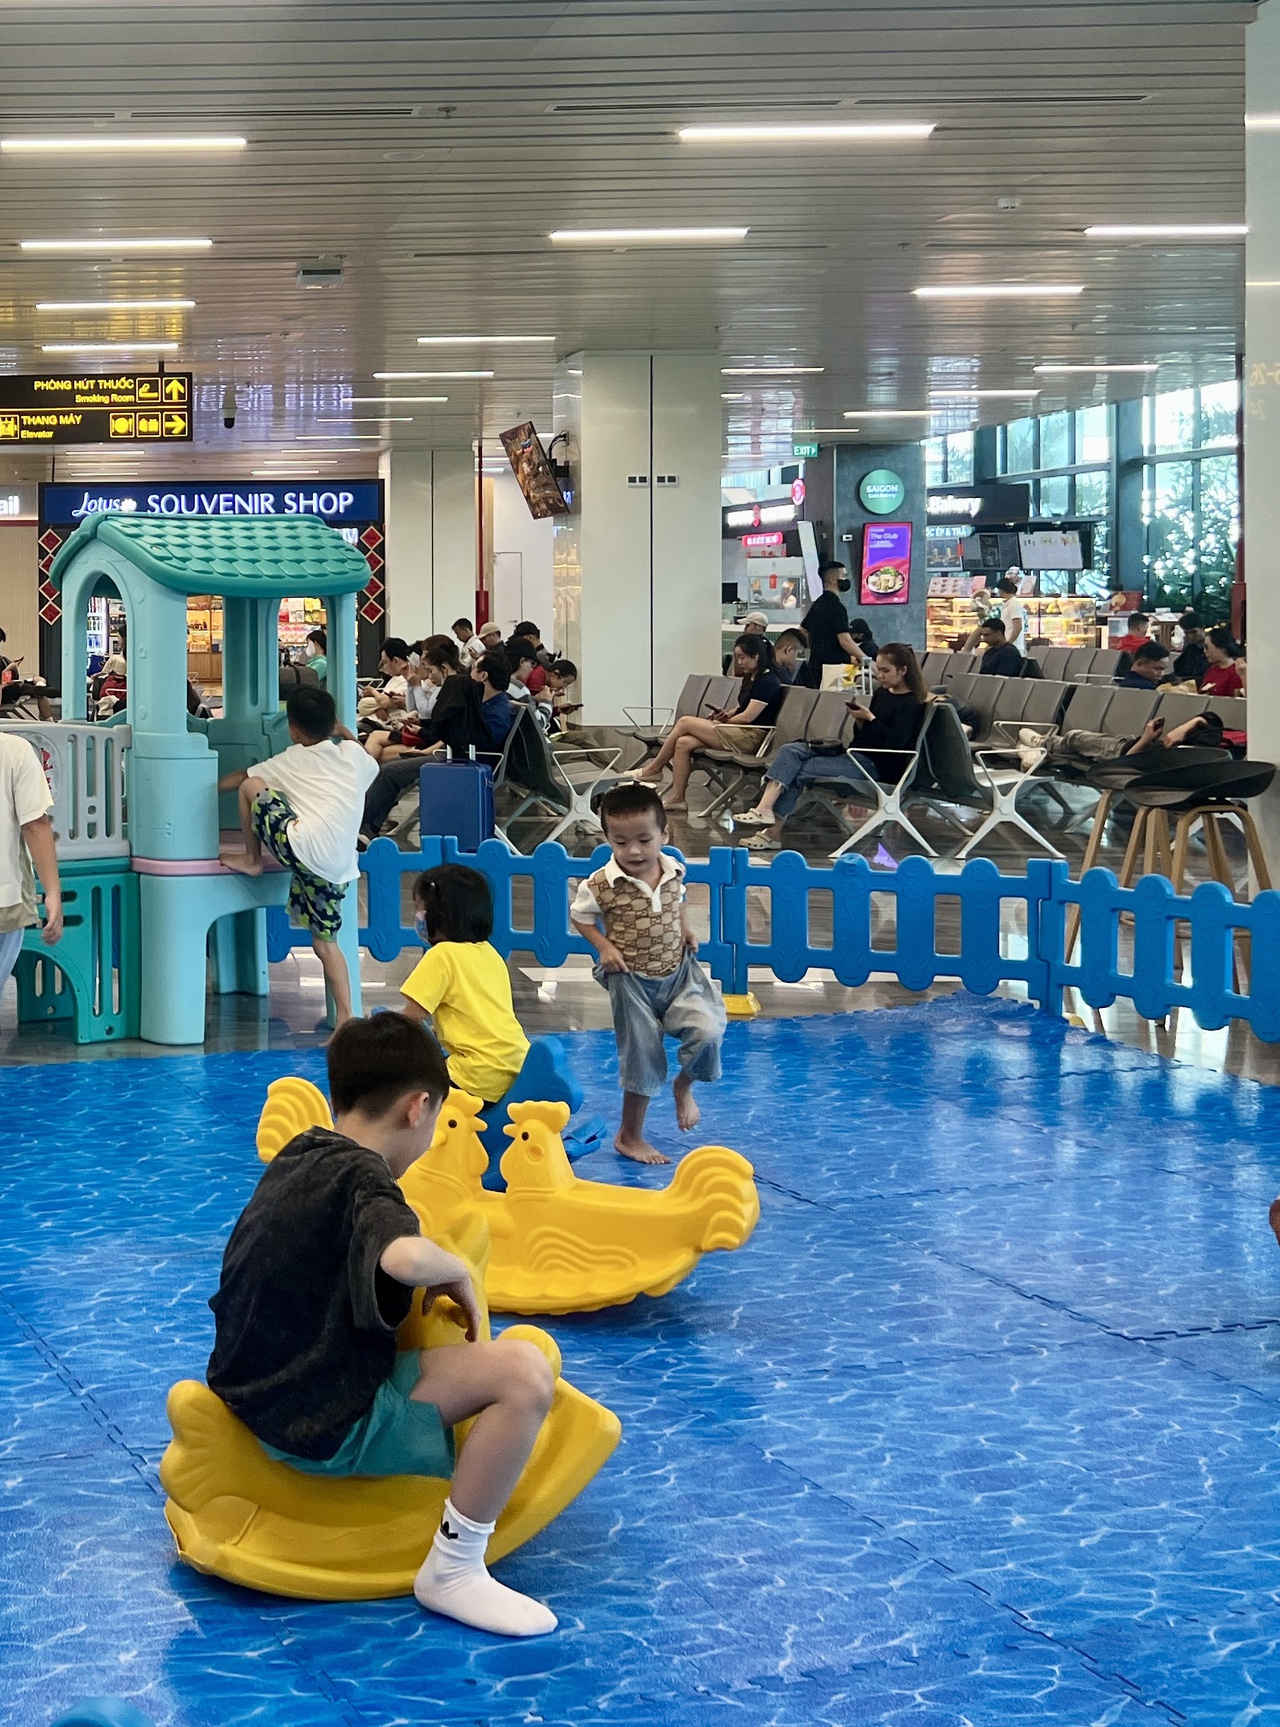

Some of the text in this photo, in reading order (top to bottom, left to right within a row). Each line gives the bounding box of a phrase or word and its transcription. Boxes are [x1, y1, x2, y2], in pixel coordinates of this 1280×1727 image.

[74, 378, 96, 390] HÚT
[98, 377, 134, 390] THUỐC
[75, 394, 135, 404] Smoking Room
[21, 413, 83, 426] THANG MÁY
[21, 430, 54, 439] Elevator
[793, 445, 811, 456] EXIT
[72, 491, 354, 517] Lotus SOUVENIR SHOP
